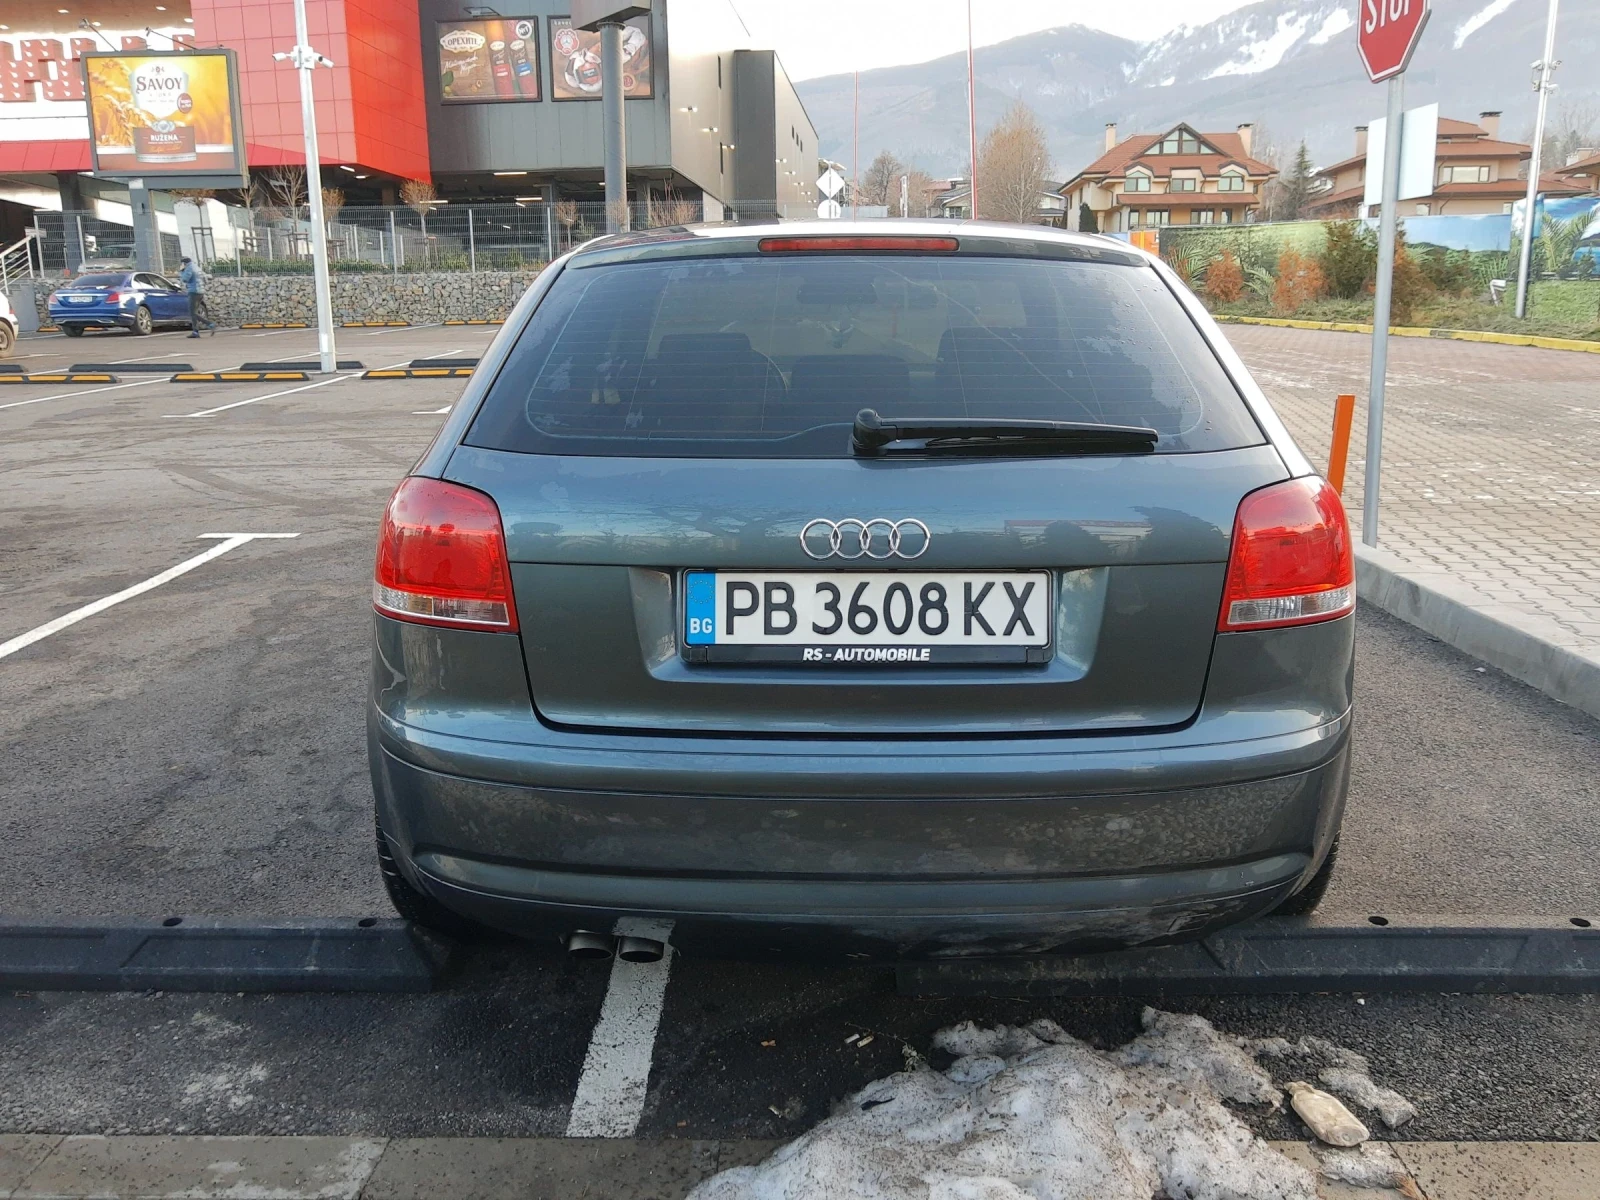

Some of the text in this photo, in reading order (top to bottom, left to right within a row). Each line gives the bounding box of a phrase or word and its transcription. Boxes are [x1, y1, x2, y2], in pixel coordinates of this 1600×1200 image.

[1366, 0, 1409, 34] ST
[136, 76, 182, 94] SAVOY
[726, 581, 1036, 636] PB 3608 KX
[690, 618, 713, 633] BG
